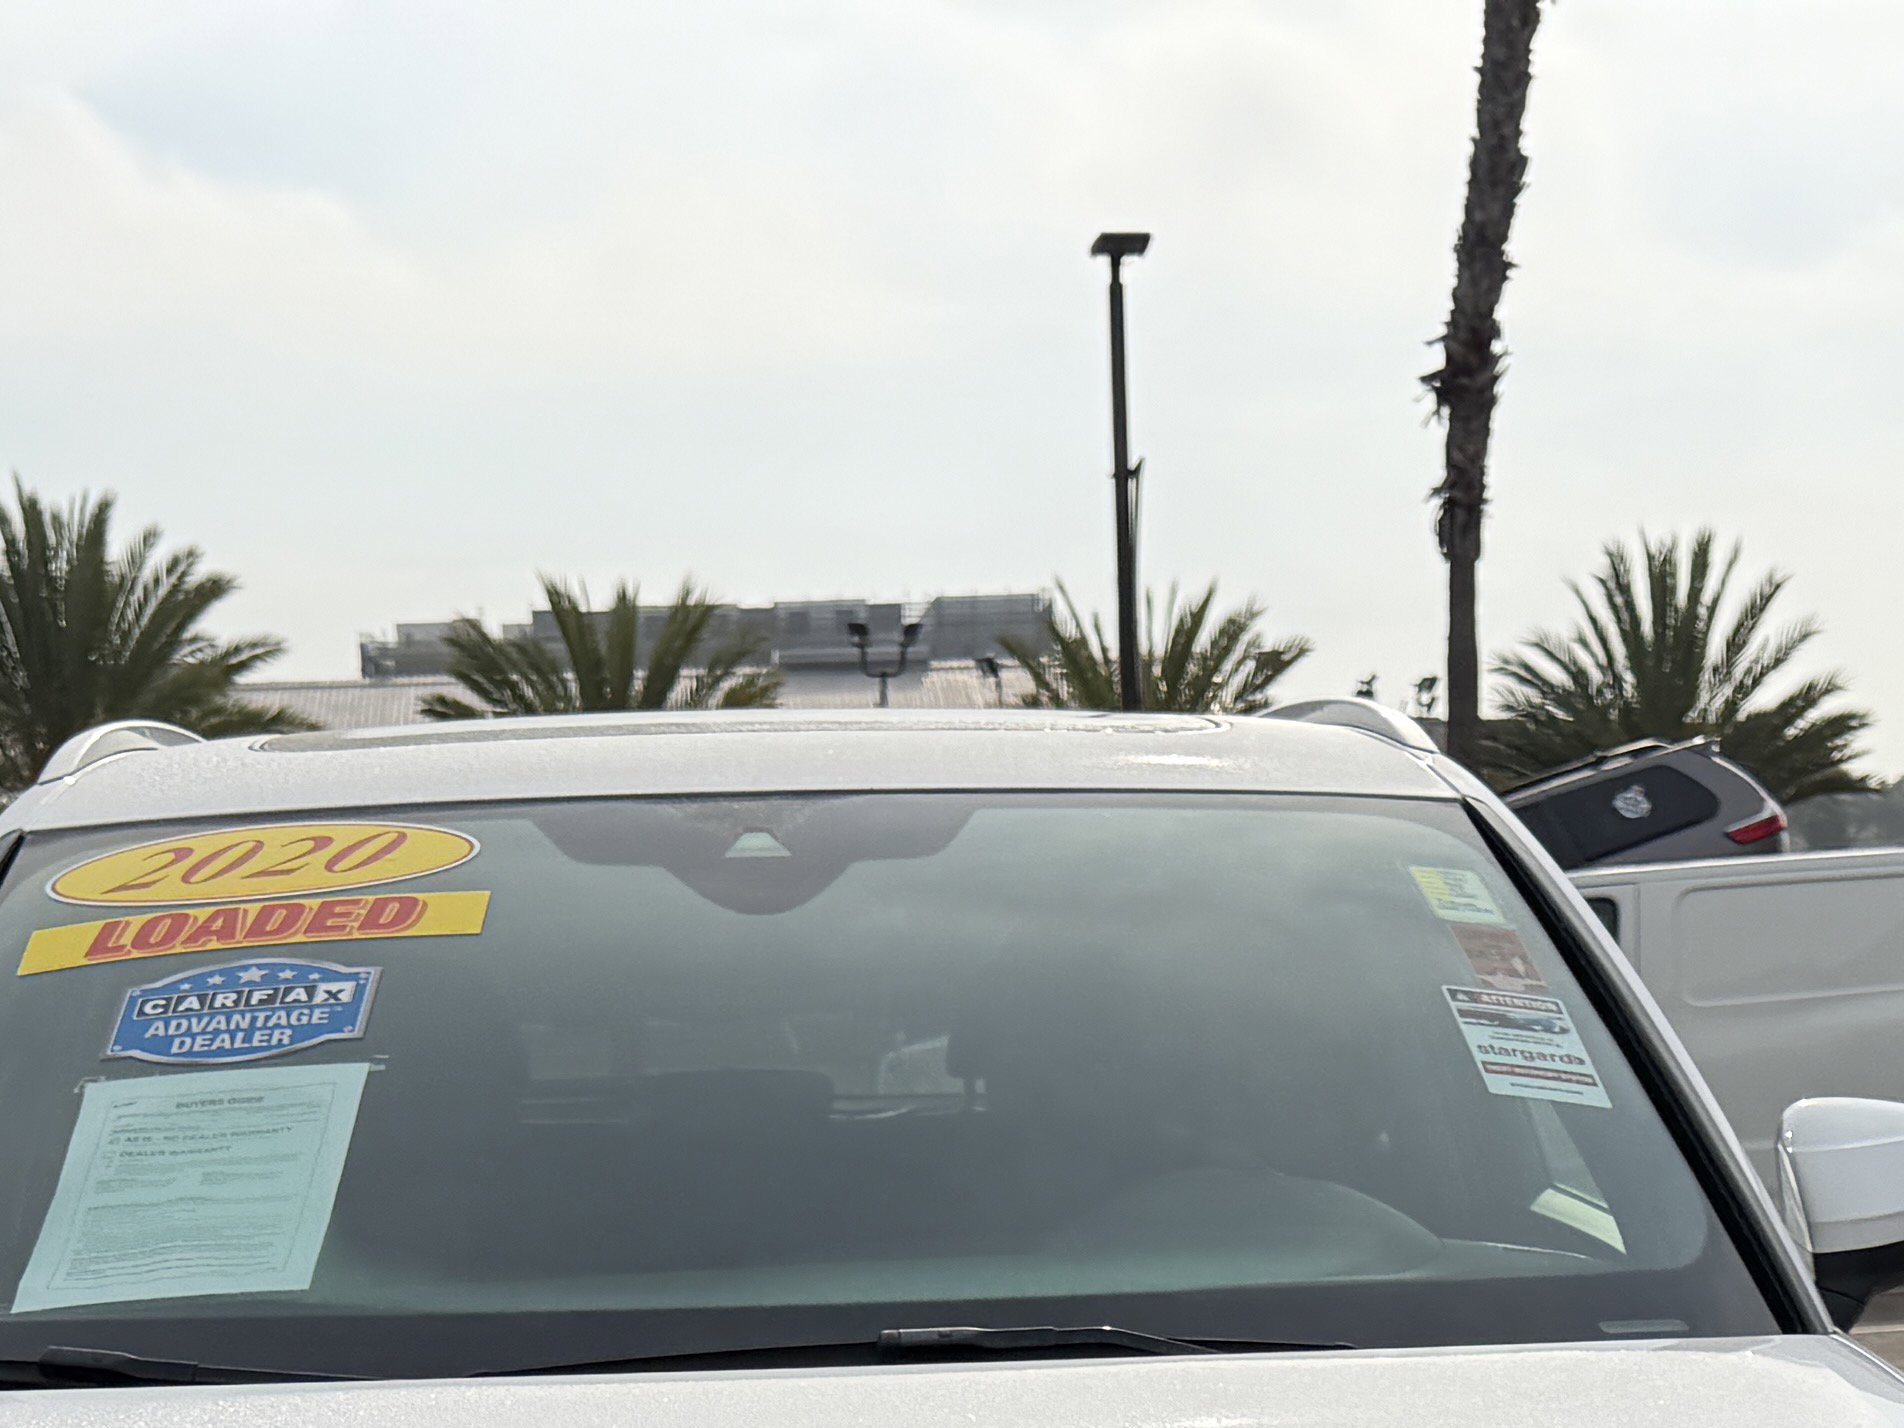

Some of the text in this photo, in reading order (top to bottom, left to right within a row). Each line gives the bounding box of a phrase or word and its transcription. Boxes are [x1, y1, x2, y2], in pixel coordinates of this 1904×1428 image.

[100, 831, 408, 895] 2020
[83, 895, 428, 962] LOADED
[136, 982, 355, 1018] CARFAX
[144, 1009, 330, 1039] ADVANTAGE
[170, 1028, 292, 1055] DEALER
